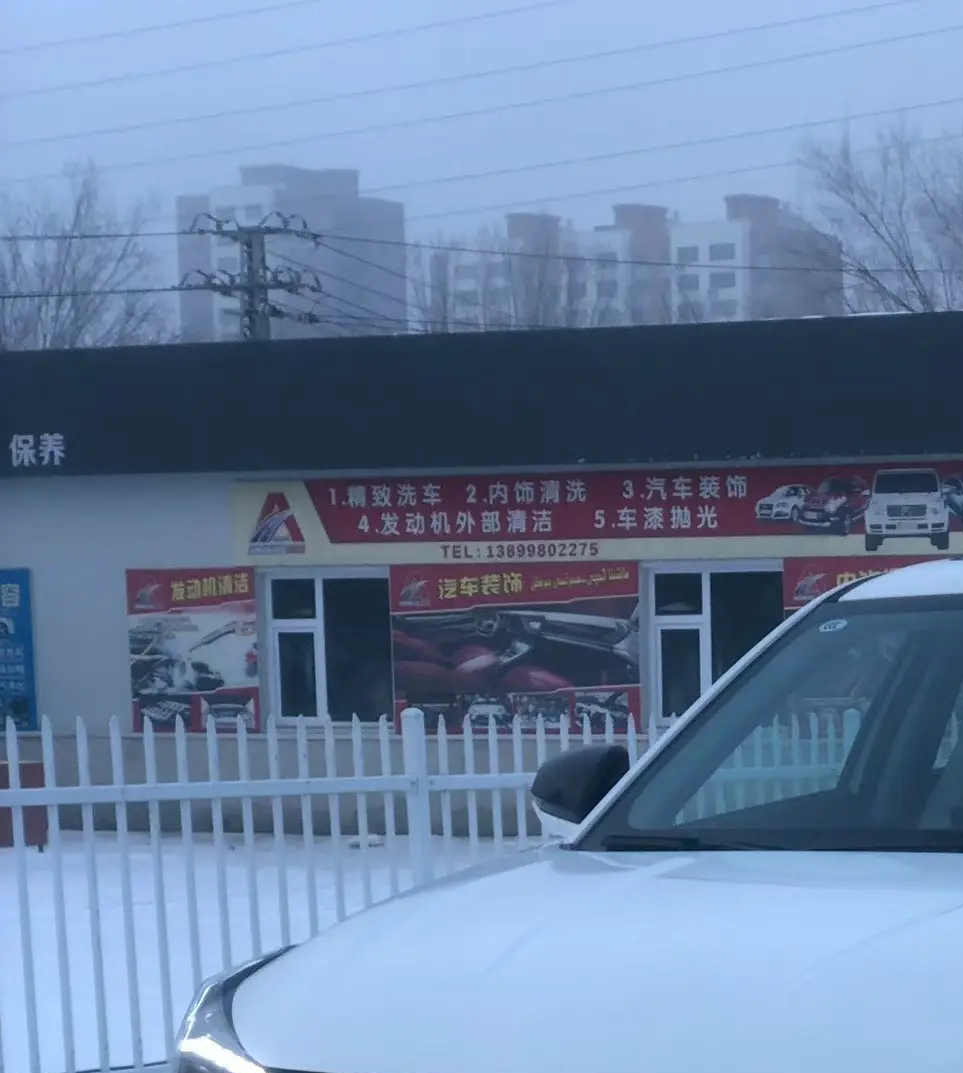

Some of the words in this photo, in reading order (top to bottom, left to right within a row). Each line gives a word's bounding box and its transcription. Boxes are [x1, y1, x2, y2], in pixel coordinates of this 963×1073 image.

[9, 432, 66, 467] 保养
[622, 475, 748, 500] 3.汽车装饰
[358, 509, 553, 535] 4.发动机外部清洁
[594, 504, 719, 530] 5.车漆抛光
[441, 541, 600, 560] TEL:13899802275
[438, 571, 523, 600] 汽车装饰
